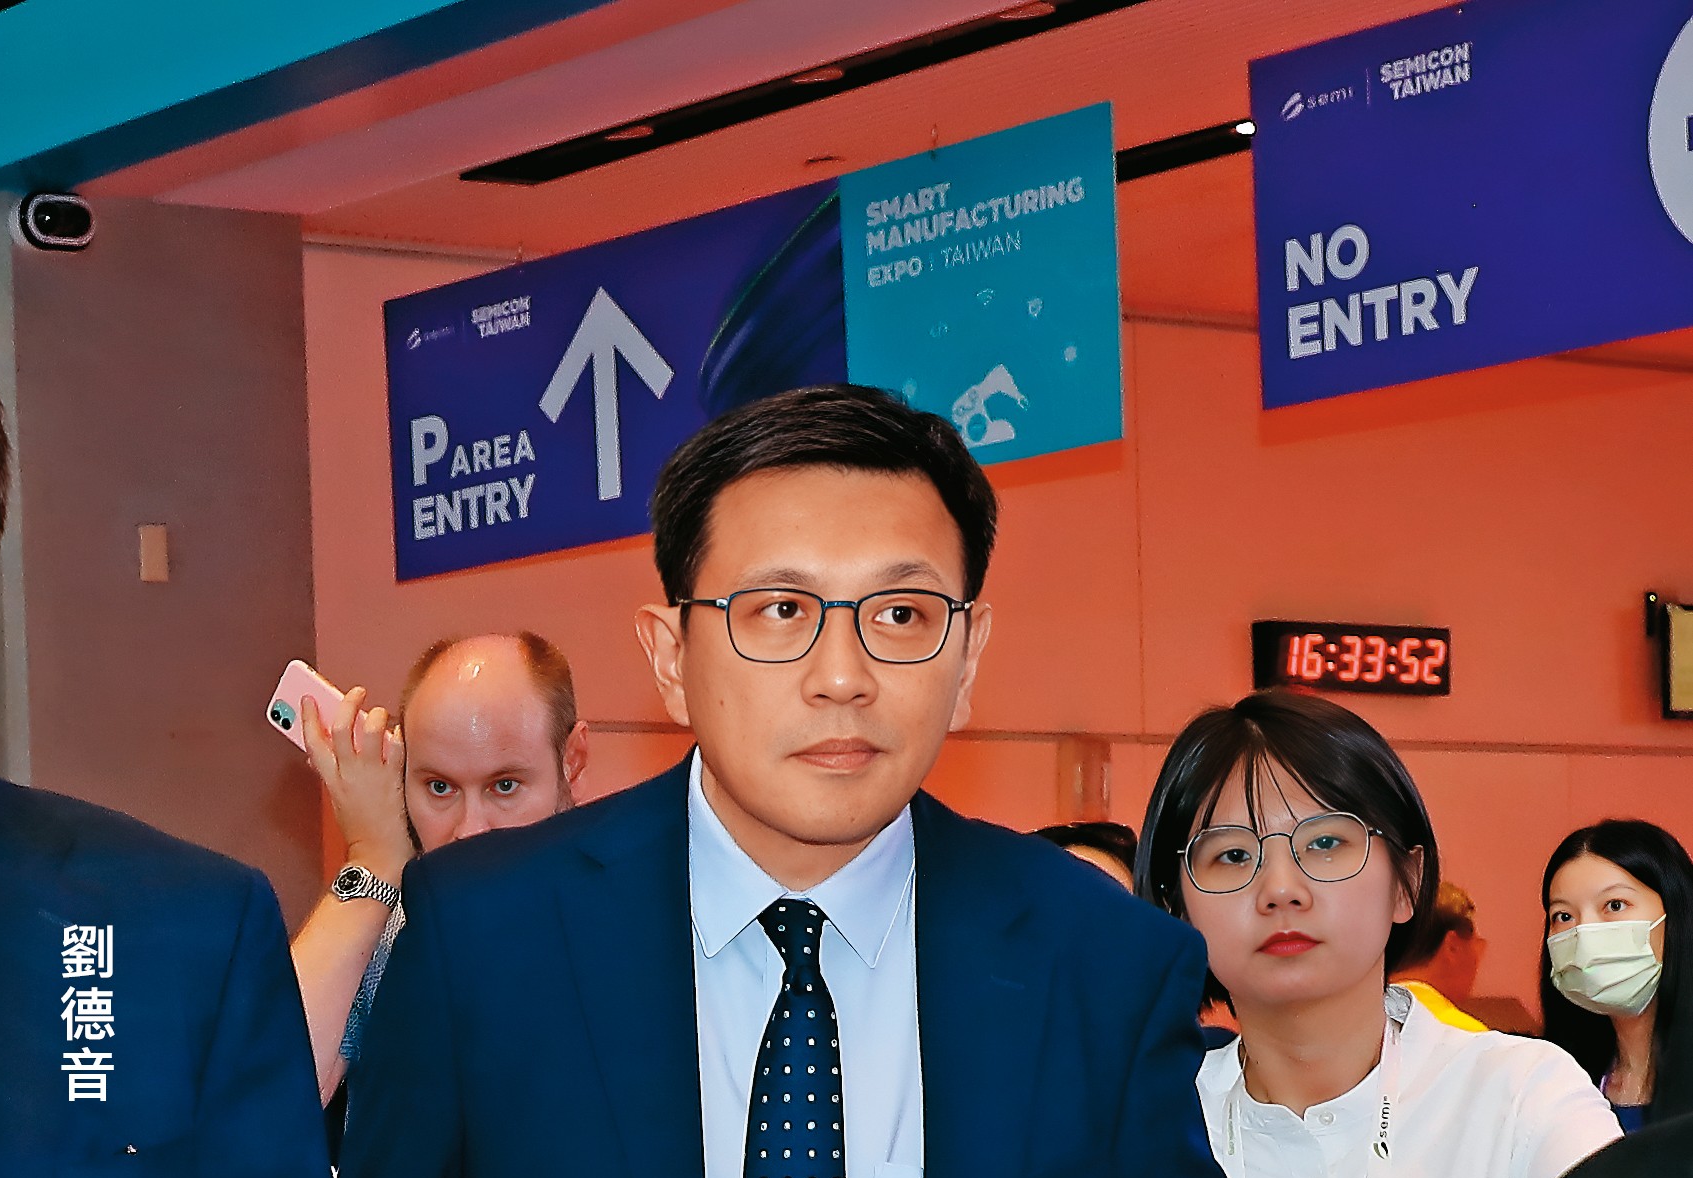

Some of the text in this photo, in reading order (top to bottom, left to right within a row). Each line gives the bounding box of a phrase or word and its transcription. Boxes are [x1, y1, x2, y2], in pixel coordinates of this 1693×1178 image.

[1379, 41, 1472, 84] SEMICON
[1389, 63, 1472, 101] TAIWAN
[866, 182, 951, 227] SMART
[866, 176, 1086, 256] MANUFACTURING
[868, 230, 1022, 288] EXPO TAIWAN
[1284, 223, 1370, 292] NO
[1287, 266, 1479, 360] ENTRY
[450, 430, 537, 480] AREA
[412, 474, 537, 542] ENTRY
[1287, 633, 1447, 685] 16:33:52
